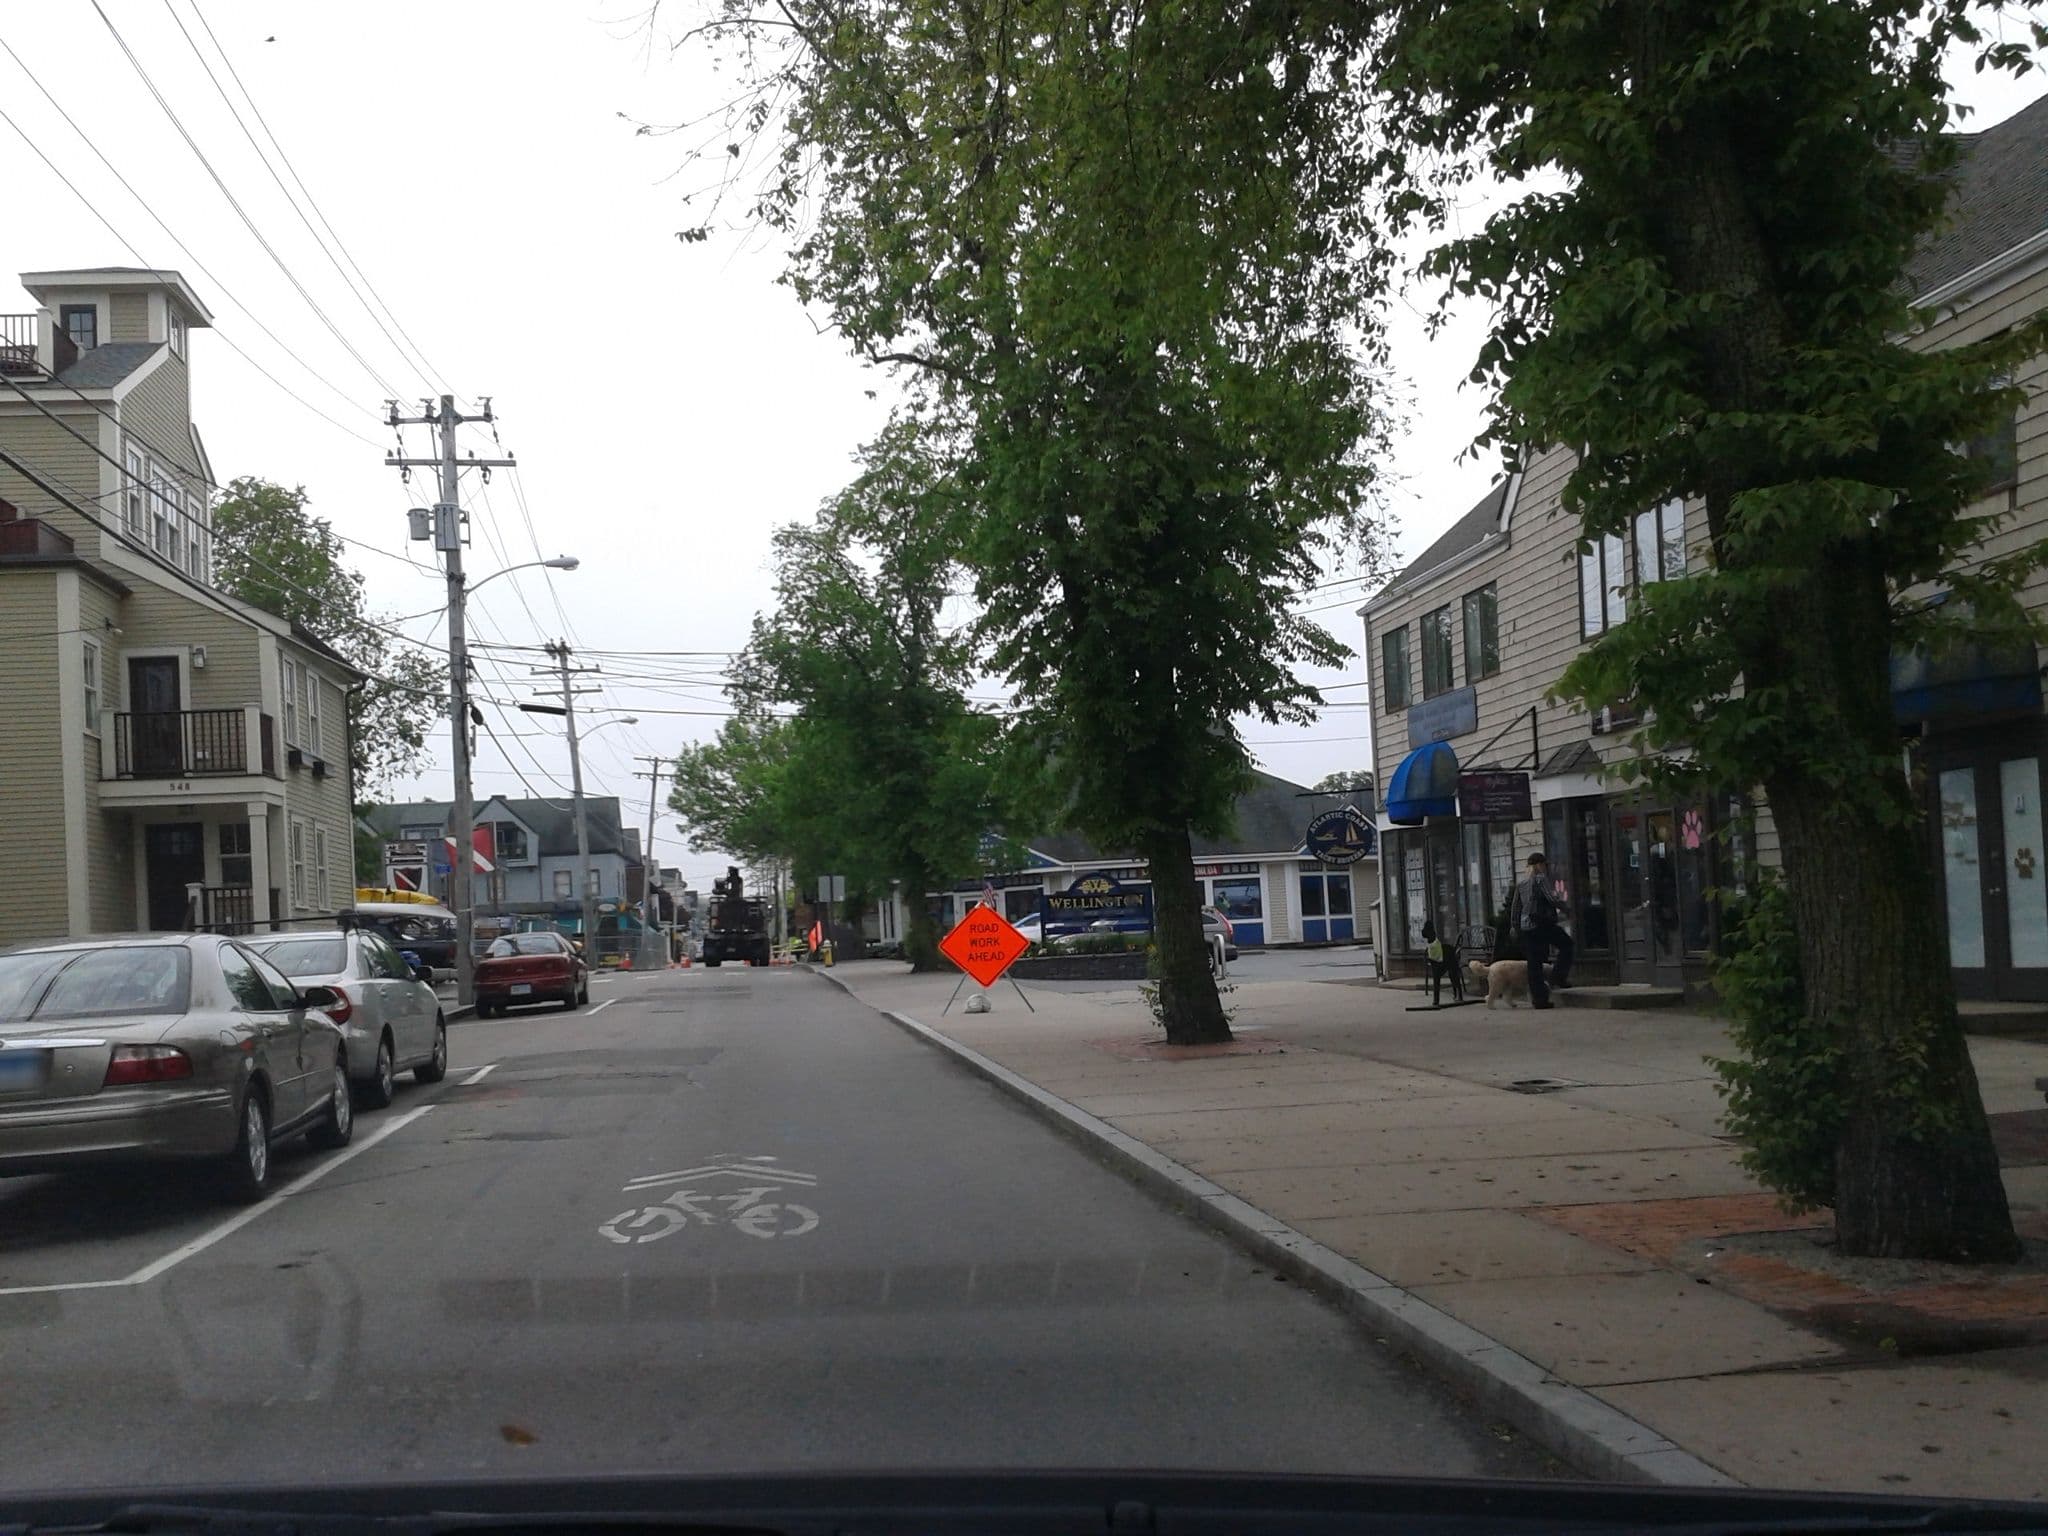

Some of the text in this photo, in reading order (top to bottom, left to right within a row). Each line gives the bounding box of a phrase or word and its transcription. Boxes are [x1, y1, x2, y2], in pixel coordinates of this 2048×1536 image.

[1048, 894, 1144, 909] WELLINGTON
[969, 923, 999, 934] ROAD
[969, 937, 1000, 948] WORK
[968, 951, 1006, 962] AHEAD
